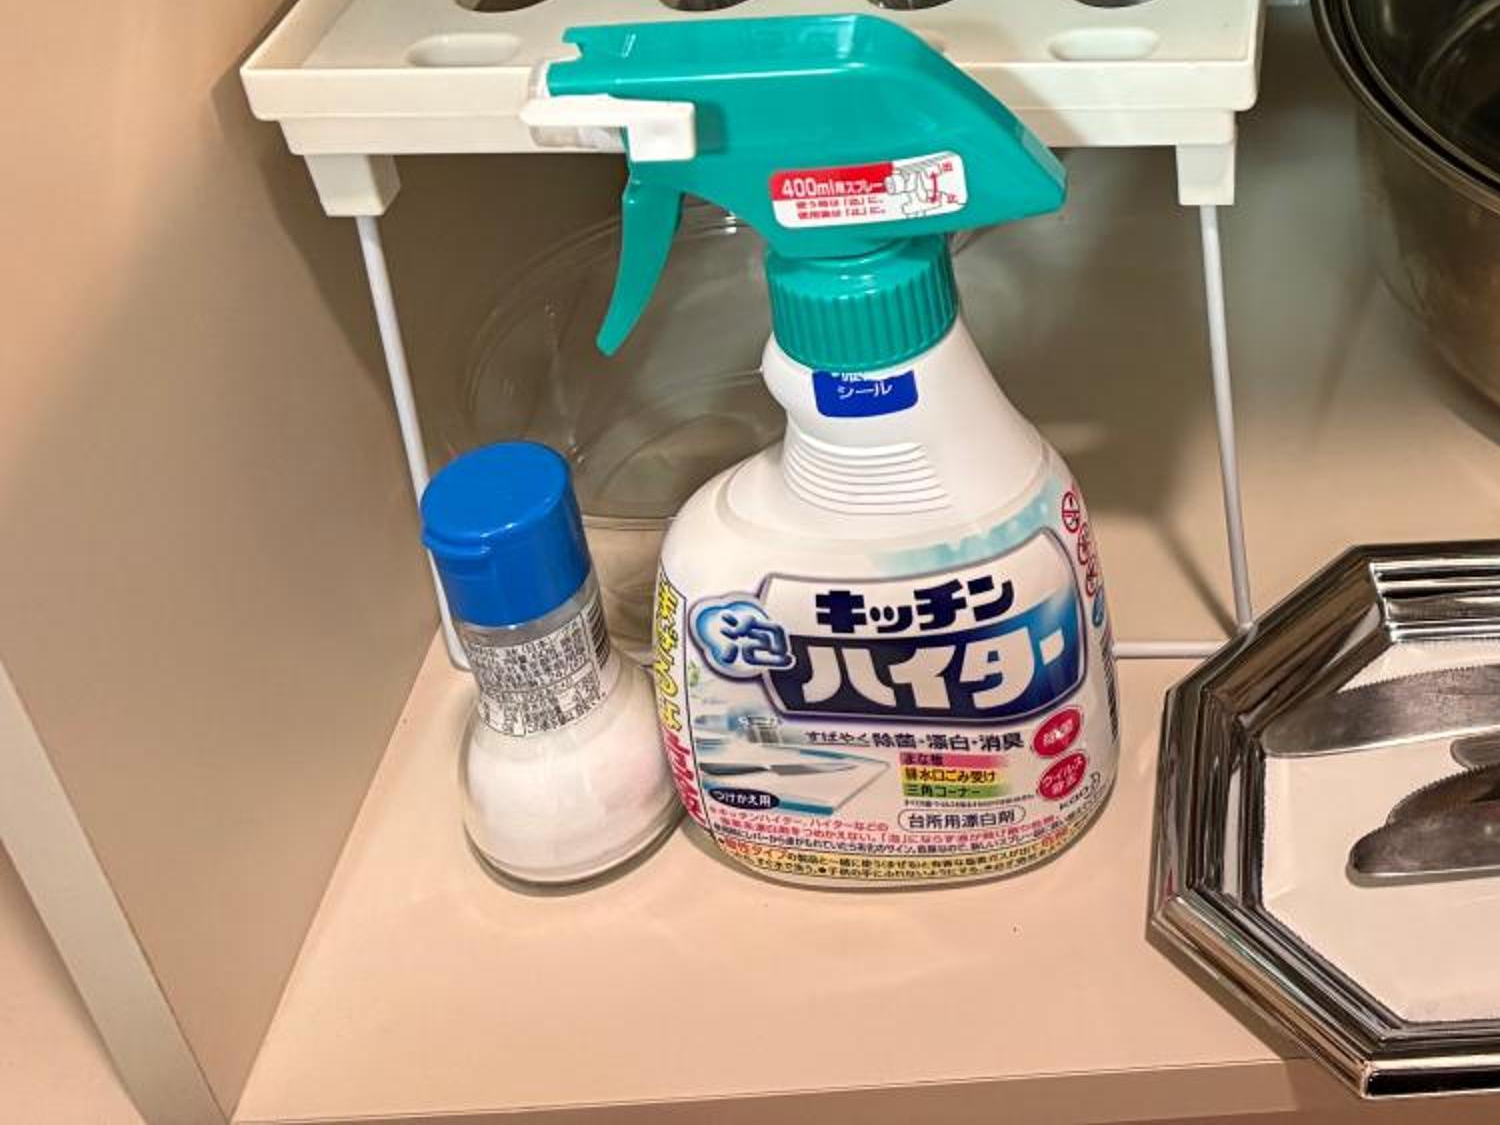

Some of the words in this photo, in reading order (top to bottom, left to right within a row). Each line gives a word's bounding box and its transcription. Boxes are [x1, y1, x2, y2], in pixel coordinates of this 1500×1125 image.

[836, 382, 894, 400] シール
[815, 574, 1014, 633] キッチン
[720, 614, 795, 667] 泡
[801, 627, 1064, 710] ハイター
[905, 768, 996, 783] 排水口ごみ受け
[907, 785, 981, 797] 三角コーナー
[908, 809, 1016, 830] 台所用漂白剤
